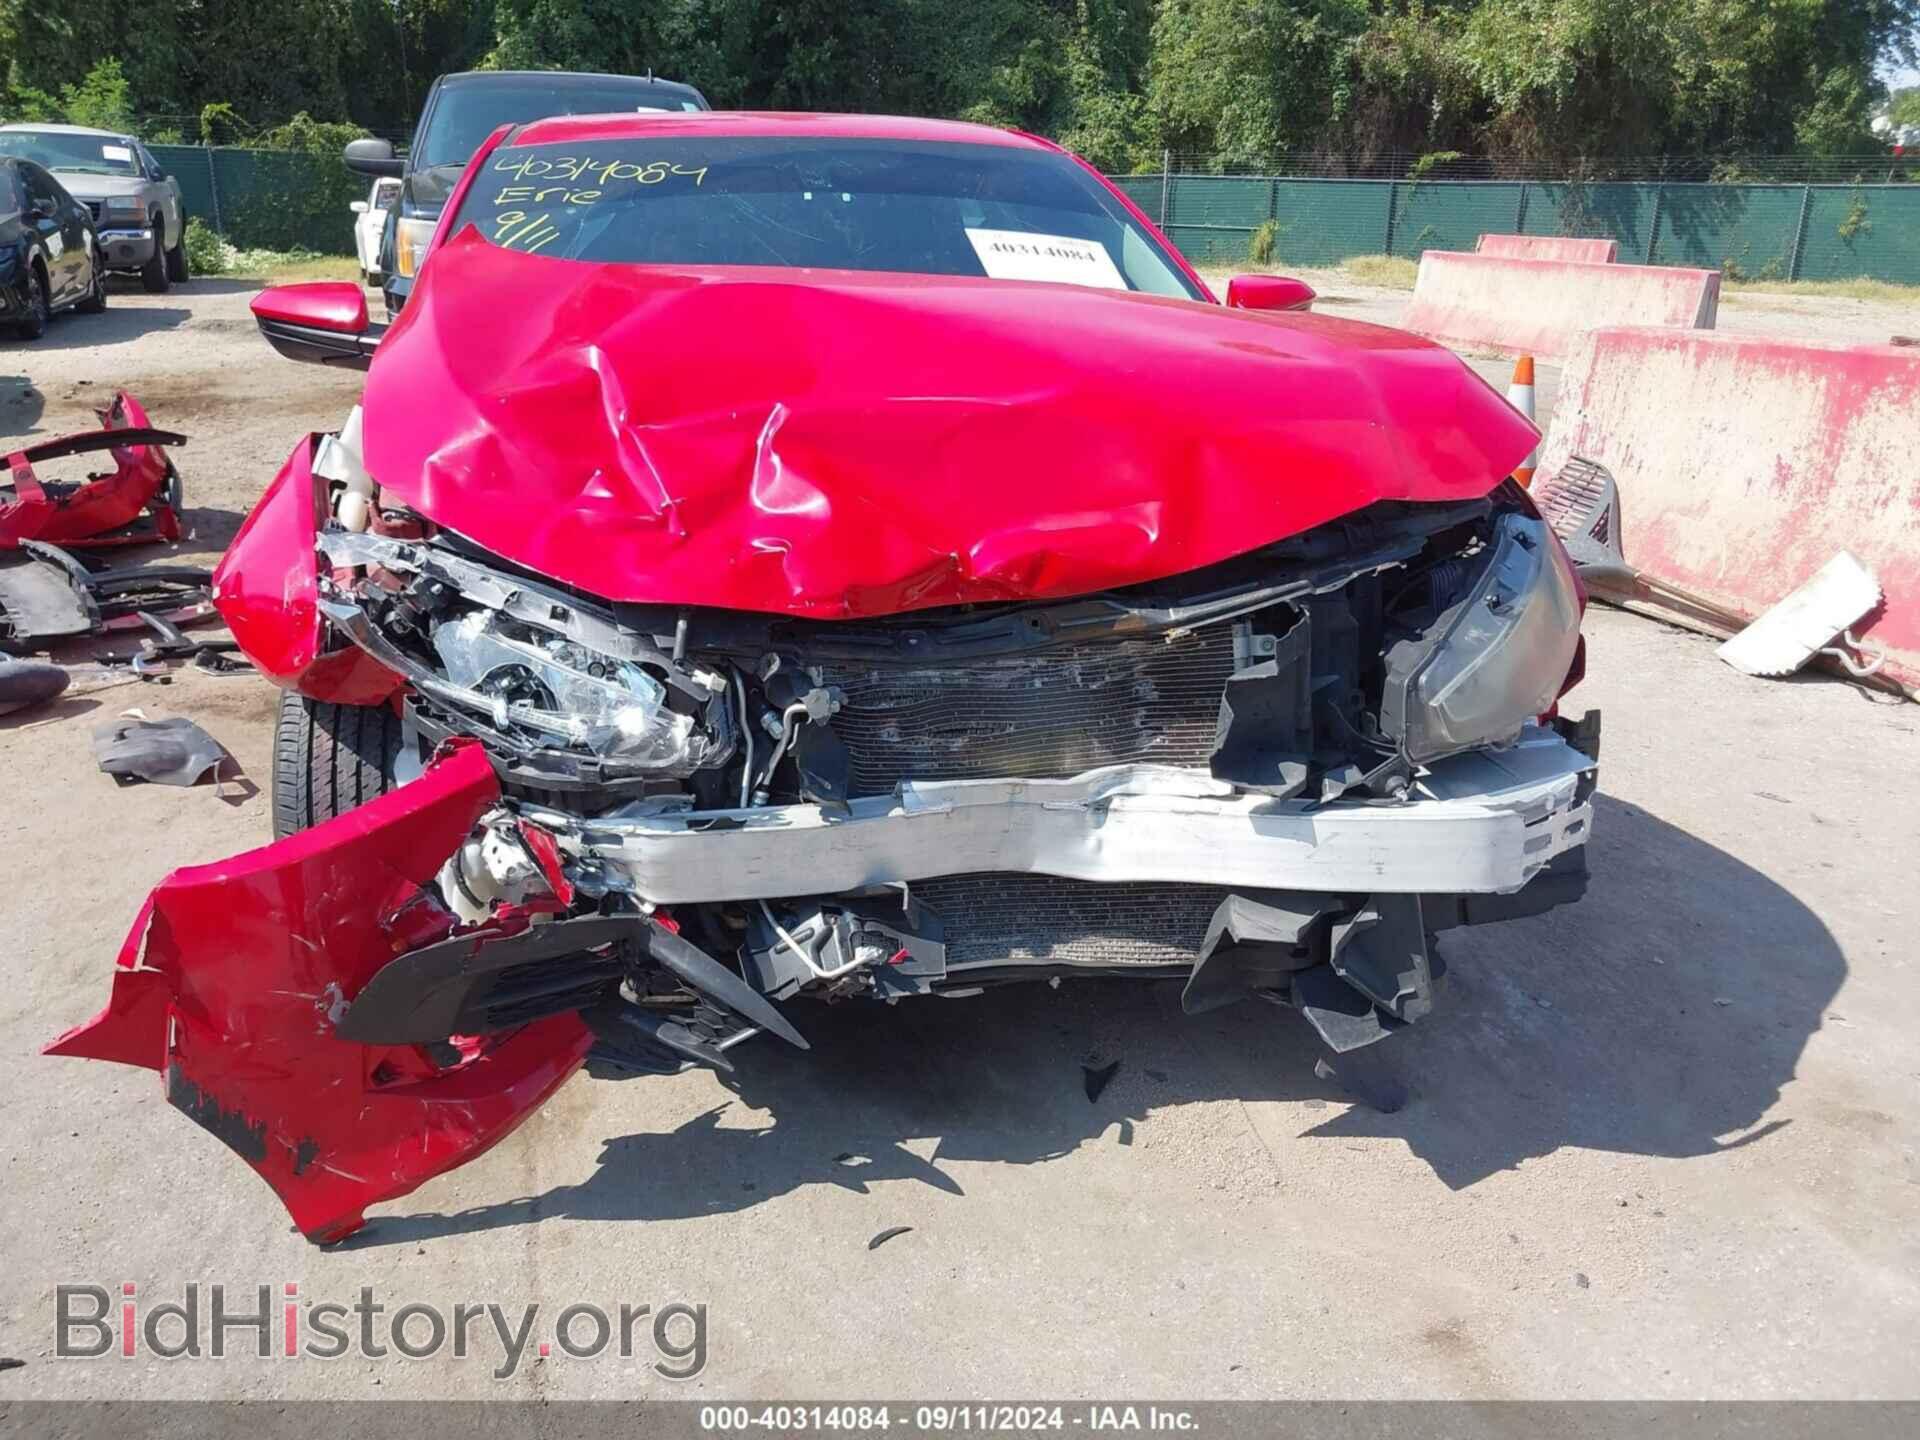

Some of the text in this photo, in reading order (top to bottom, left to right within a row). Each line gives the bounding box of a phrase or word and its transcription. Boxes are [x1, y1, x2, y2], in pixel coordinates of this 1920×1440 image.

[494, 154, 707, 186] 40314084
[494, 210, 560, 254] 9/11
[989, 242, 1097, 262] 40314084
